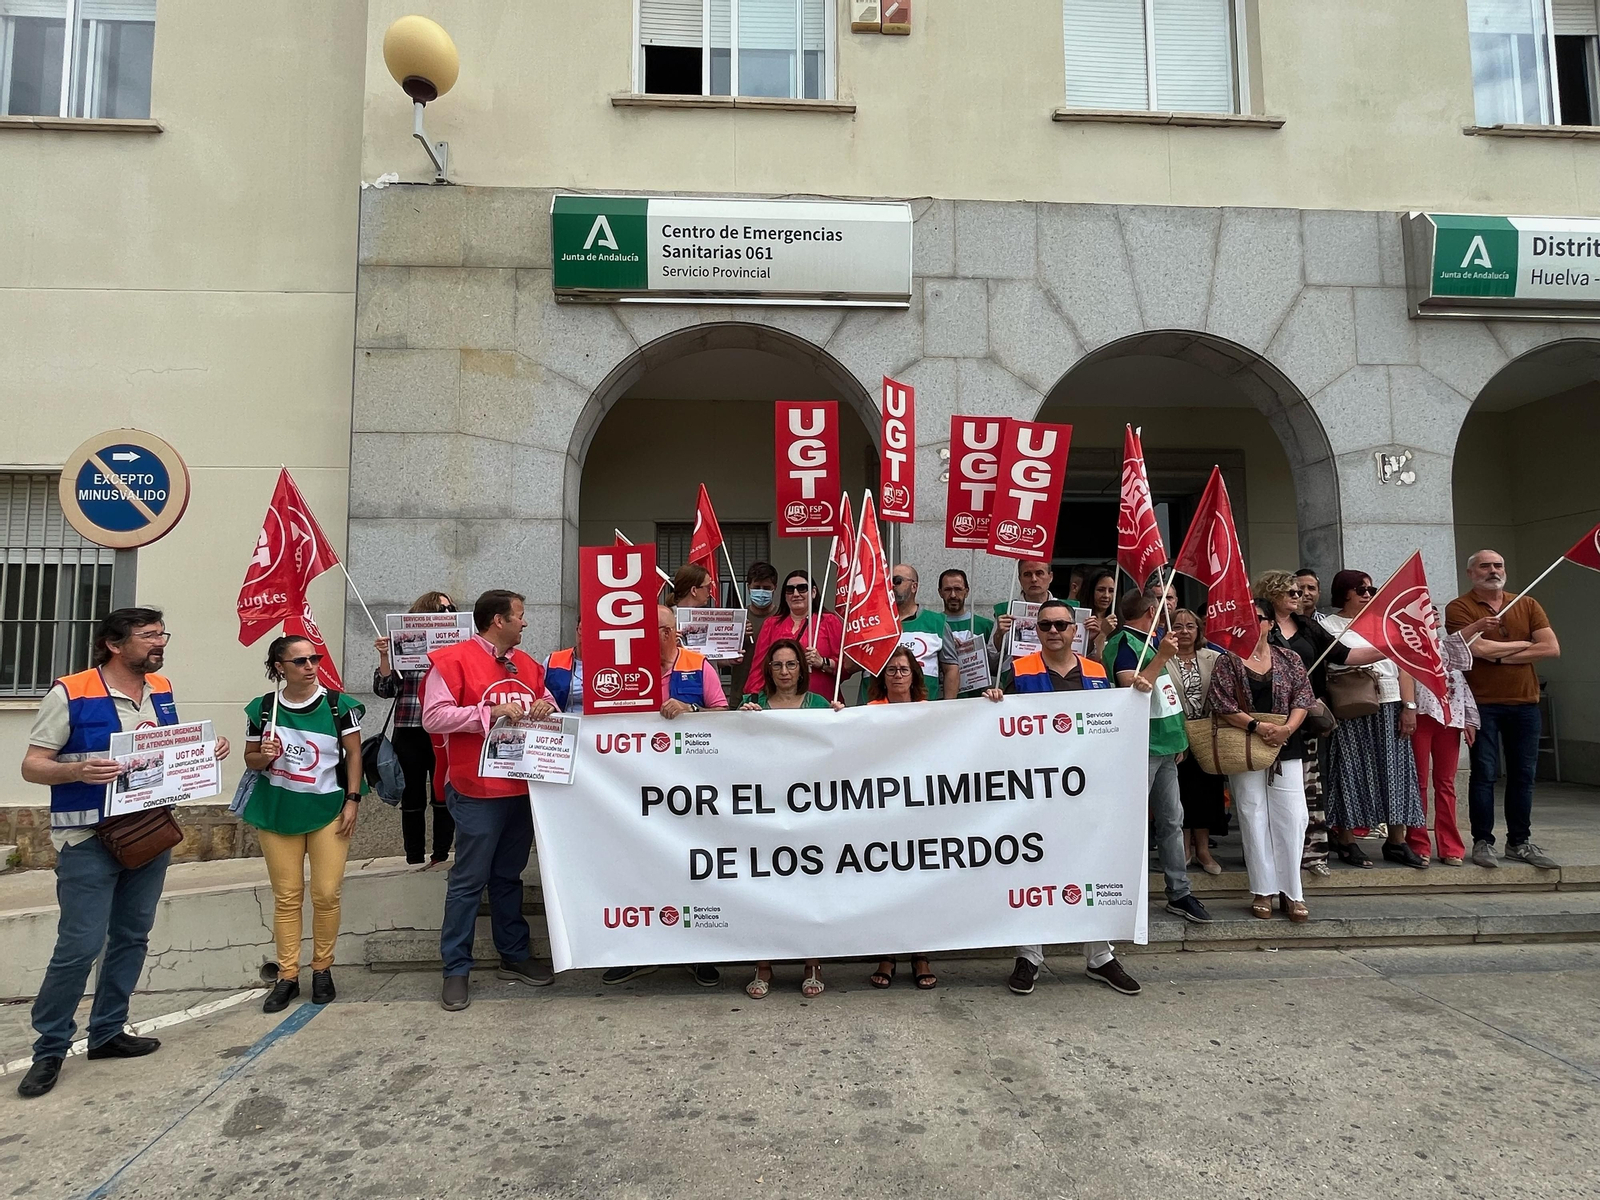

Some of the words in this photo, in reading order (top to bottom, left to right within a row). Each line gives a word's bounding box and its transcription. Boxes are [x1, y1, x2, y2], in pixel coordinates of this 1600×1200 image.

[661, 224, 716, 240] Centro
[718, 225, 739, 240] de
[742, 226, 844, 245] Emergencias
[661, 244, 742, 260] Sanitarias
[745, 246, 774, 260] 061
[1532, 236, 1600, 257] Distrit
[561, 252, 586, 263] Junta
[586, 252, 597, 262] de
[598, 252, 640, 263] Andalucía
[662, 265, 709, 278] Servicio
[712, 266, 771, 279] Provincial
[1440, 271, 1461, 279] Junta
[1462, 271, 1473, 279] de
[1473, 271, 1510, 280] Andalucía
[1530, 268, 1590, 286] Huelva
[885, 384, 907, 482] UGT
[788, 408, 827, 499] UGT
[959, 421, 999, 511] UGT
[94, 473, 154, 485] EXCEPTO
[1008, 427, 1058, 521] UGT
[809, 505, 823, 513] FSP
[976, 517, 990, 525] FSP
[1022, 527, 1037, 536] FSP
[596, 552, 645, 666] UGT
[448, 631, 460, 639] POR
[597, 673, 619, 685] UGT
[624, 673, 640, 682] FSP
[1085, 711, 1113, 719] Servicios
[1086, 718, 1112, 726] Públicos
[999, 715, 1048, 737] UGT
[135, 731, 163, 742] SERVICIOS
[172, 725, 202, 736] URGENCIAS
[536, 736, 548, 744] UGT
[146, 738, 173, 749] ATENCIÓN
[174, 735, 200, 745] PRIMARIA
[595, 732, 646, 754] UGT
[684, 739, 710, 747] Públicos
[175, 750, 190, 760] UGT
[191, 748, 204, 758] POR
[507, 771, 545, 780] CONCENTRACIÓN
[641, 784, 719, 817] POR
[731, 784, 775, 815] EL
[786, 765, 1086, 813] CUMPLIMIENTO
[143, 793, 191, 808] CONCENTRACIÓN
[689, 847, 738, 880] DE
[750, 845, 824, 878] LOS
[835, 832, 1044, 874] ACUERDOS
[1008, 885, 1057, 909] UGT
[1096, 890, 1122, 898] Públicos
[603, 906, 655, 929] UGT
